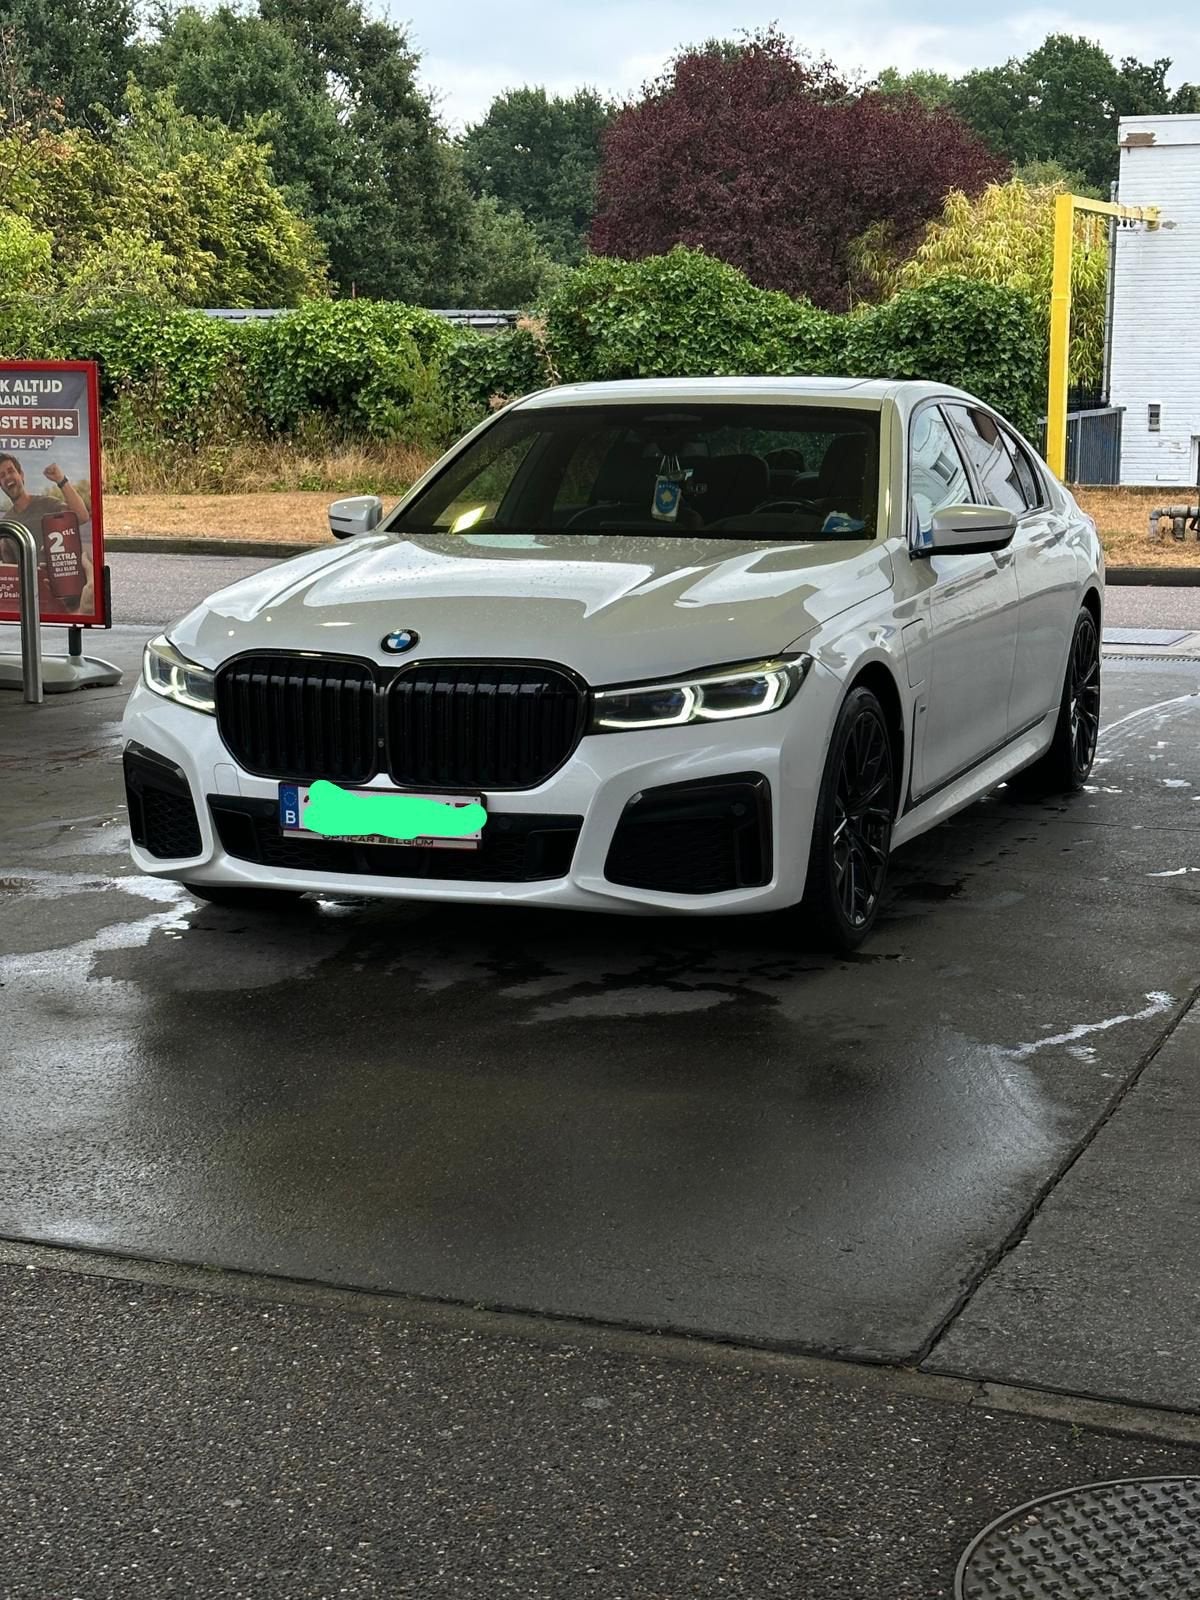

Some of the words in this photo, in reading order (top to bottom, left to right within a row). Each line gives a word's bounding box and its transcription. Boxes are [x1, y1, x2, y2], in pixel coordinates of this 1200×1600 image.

[13, 380, 62, 393] ALTIJD
[23, 396, 38, 406] DE
[0, 416, 28, 429] STE
[32, 417, 73, 429] PRIJS
[11, 439, 25, 449] DE
[29, 439, 52, 449] APP
[48, 531, 65, 553] 2
[51, 552, 77, 561] EXTRA
[286, 810, 296, 824] B
